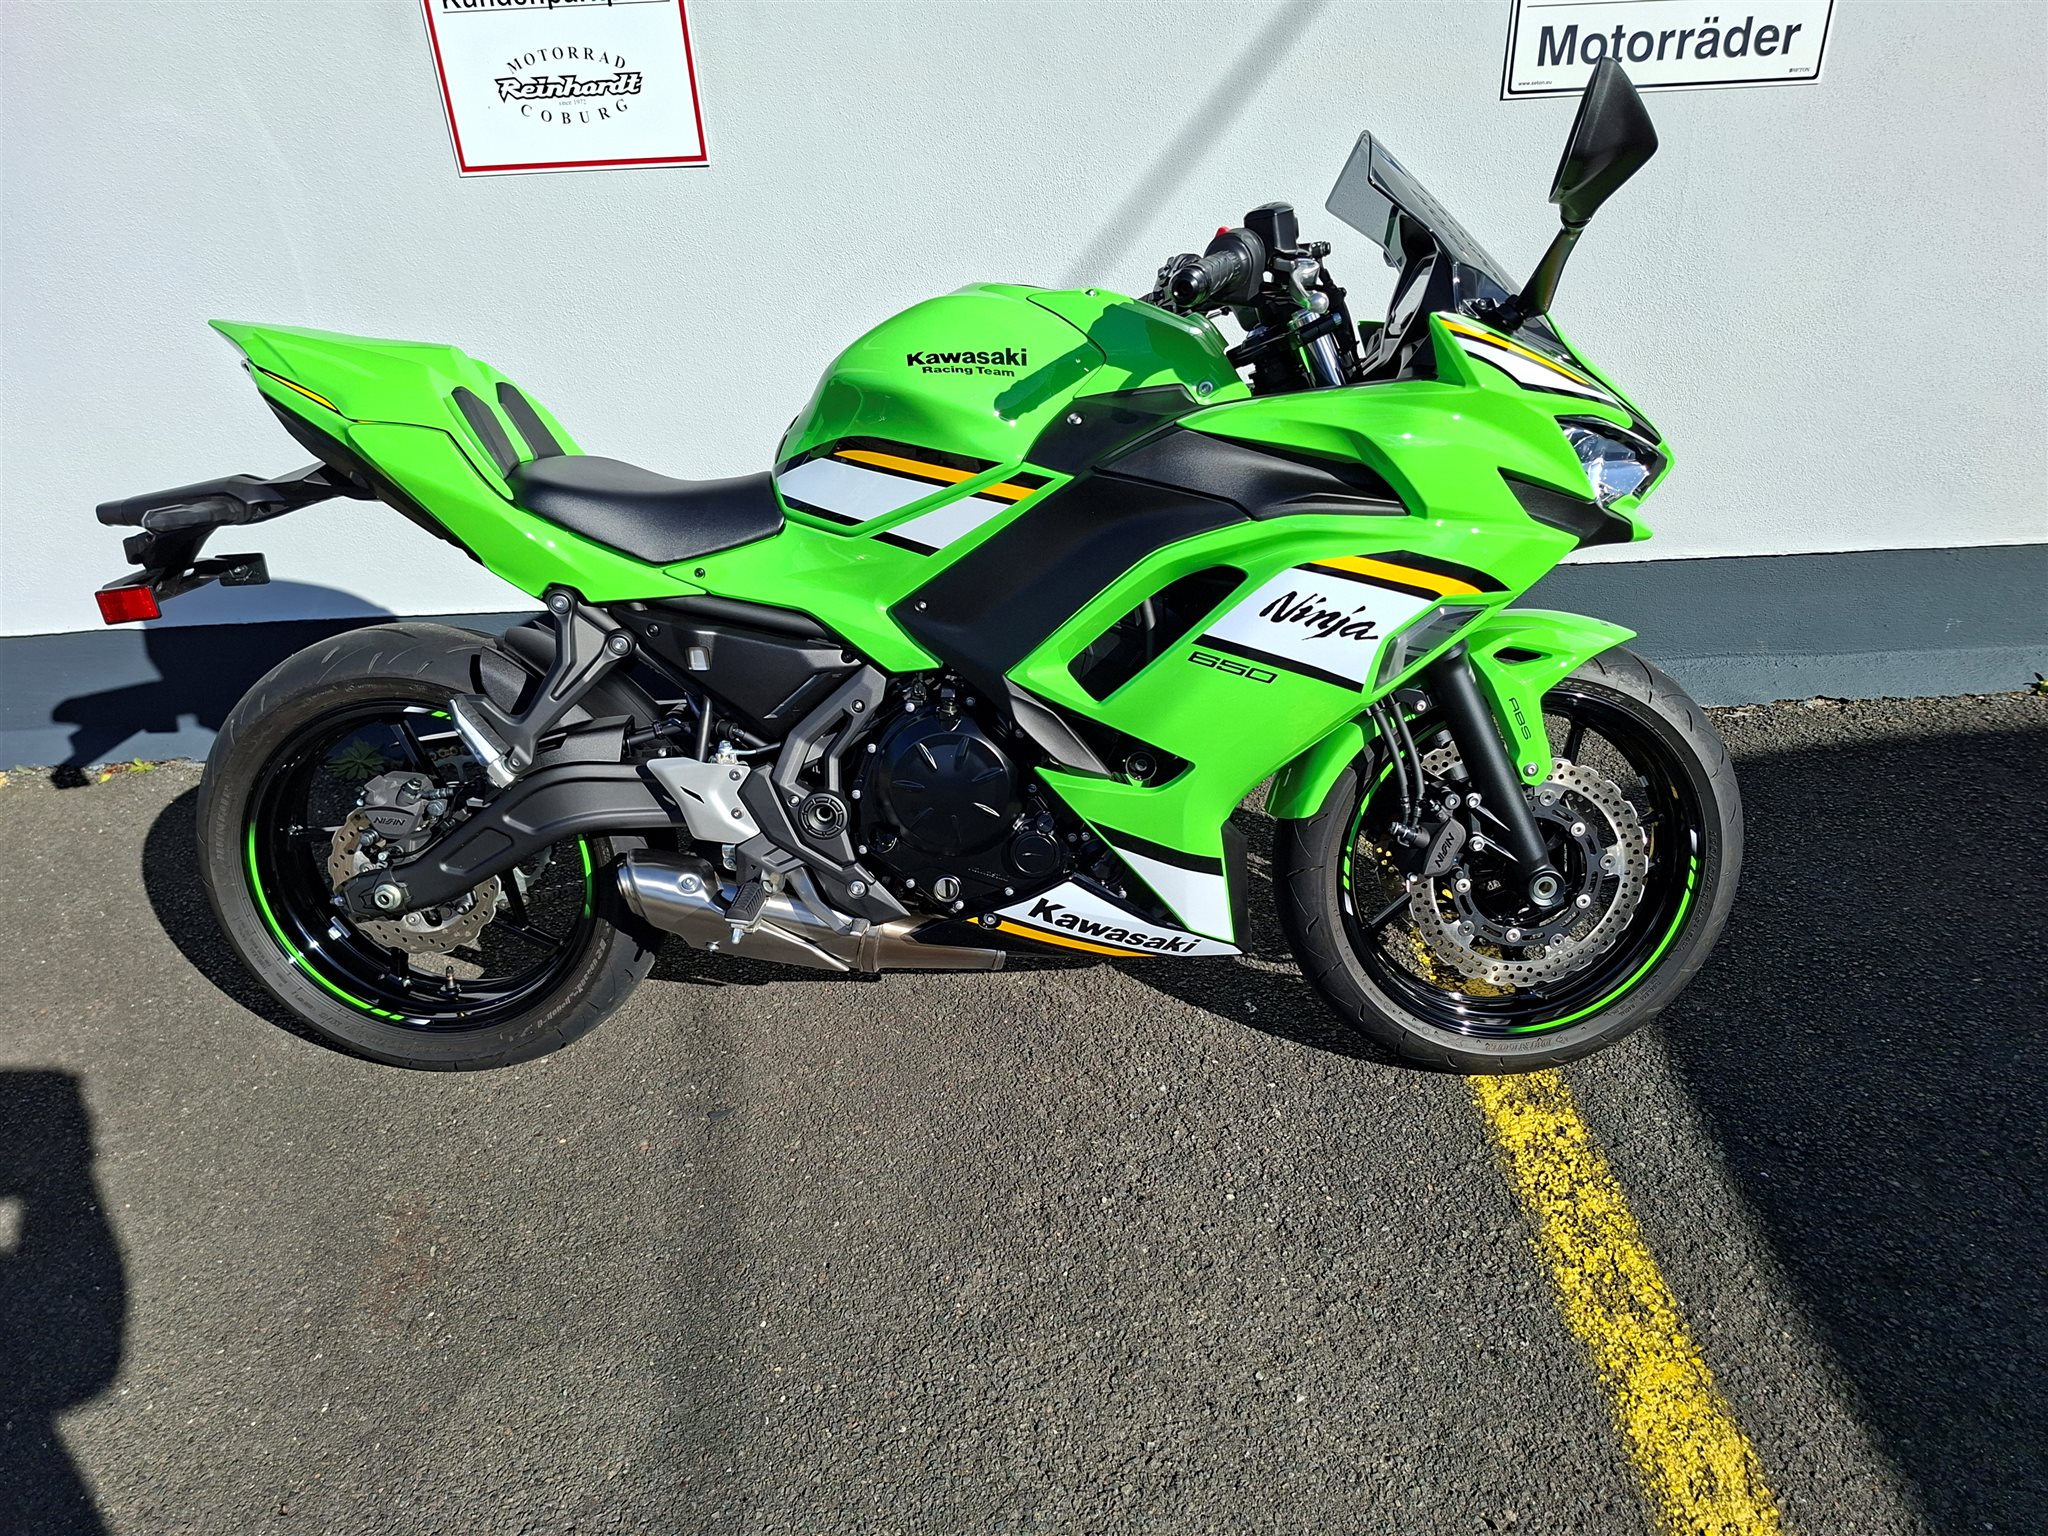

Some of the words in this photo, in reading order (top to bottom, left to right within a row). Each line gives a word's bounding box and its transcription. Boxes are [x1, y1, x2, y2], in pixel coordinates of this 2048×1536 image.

[1537, 16, 1802, 67] Motorräder
[506, 46, 626, 75] MOTORRAD
[494, 71, 643, 104] Reinhardt
[520, 98, 629, 125] COBURG
[906, 347, 1028, 367] Kawasaki
[922, 365, 973, 376] Racing
[975, 366, 1015, 377] Team
[1258, 590, 1379, 641] Ninja
[1187, 650, 1279, 684] 650
[1508, 697, 1532, 740] ABS
[1027, 897, 1202, 953] Kawasaki
